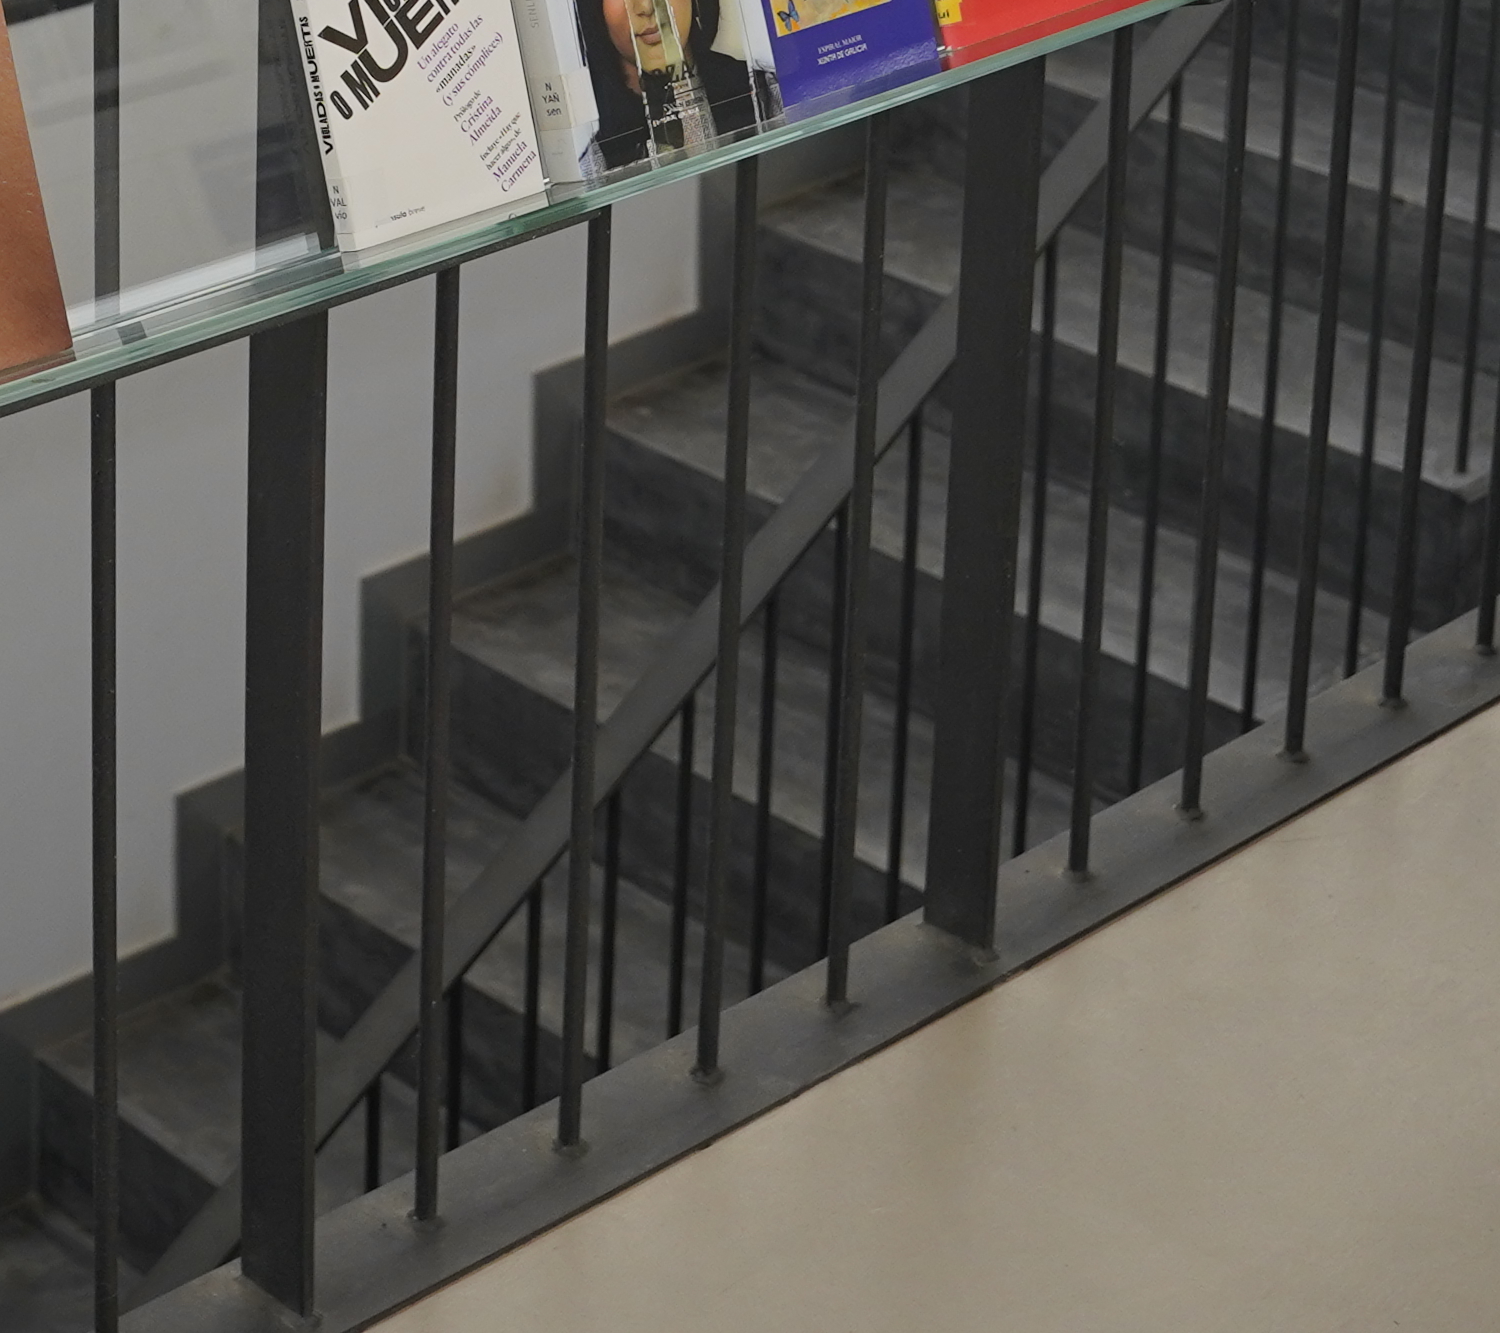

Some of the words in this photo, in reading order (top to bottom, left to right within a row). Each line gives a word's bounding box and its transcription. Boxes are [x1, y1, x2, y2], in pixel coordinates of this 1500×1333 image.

[416, 52, 433, 72] Un
[430, 23, 459, 58] alegato
[427, 52, 453, 83] contra
[450, 31, 471, 55] todas
[470, 14, 484, 32] las
[435, 44, 476, 93] «manadas»
[442, 91, 453, 107] (y
[451, 78, 466, 97] sus
[464, 31, 504, 82] cómplices)
[545, 83, 552, 91] N
[330, 90, 353, 120] O
[460, 94, 494, 133] Cristina
[542, 91, 560, 103] YAÑ
[547, 107, 562, 116] sen
[469, 105, 502, 146] Almeida
[492, 140, 528, 183] Manuela
[501, 149, 537, 192] Carmena
[330, 198, 347, 207] VAL
[333, 186, 340, 195] N
